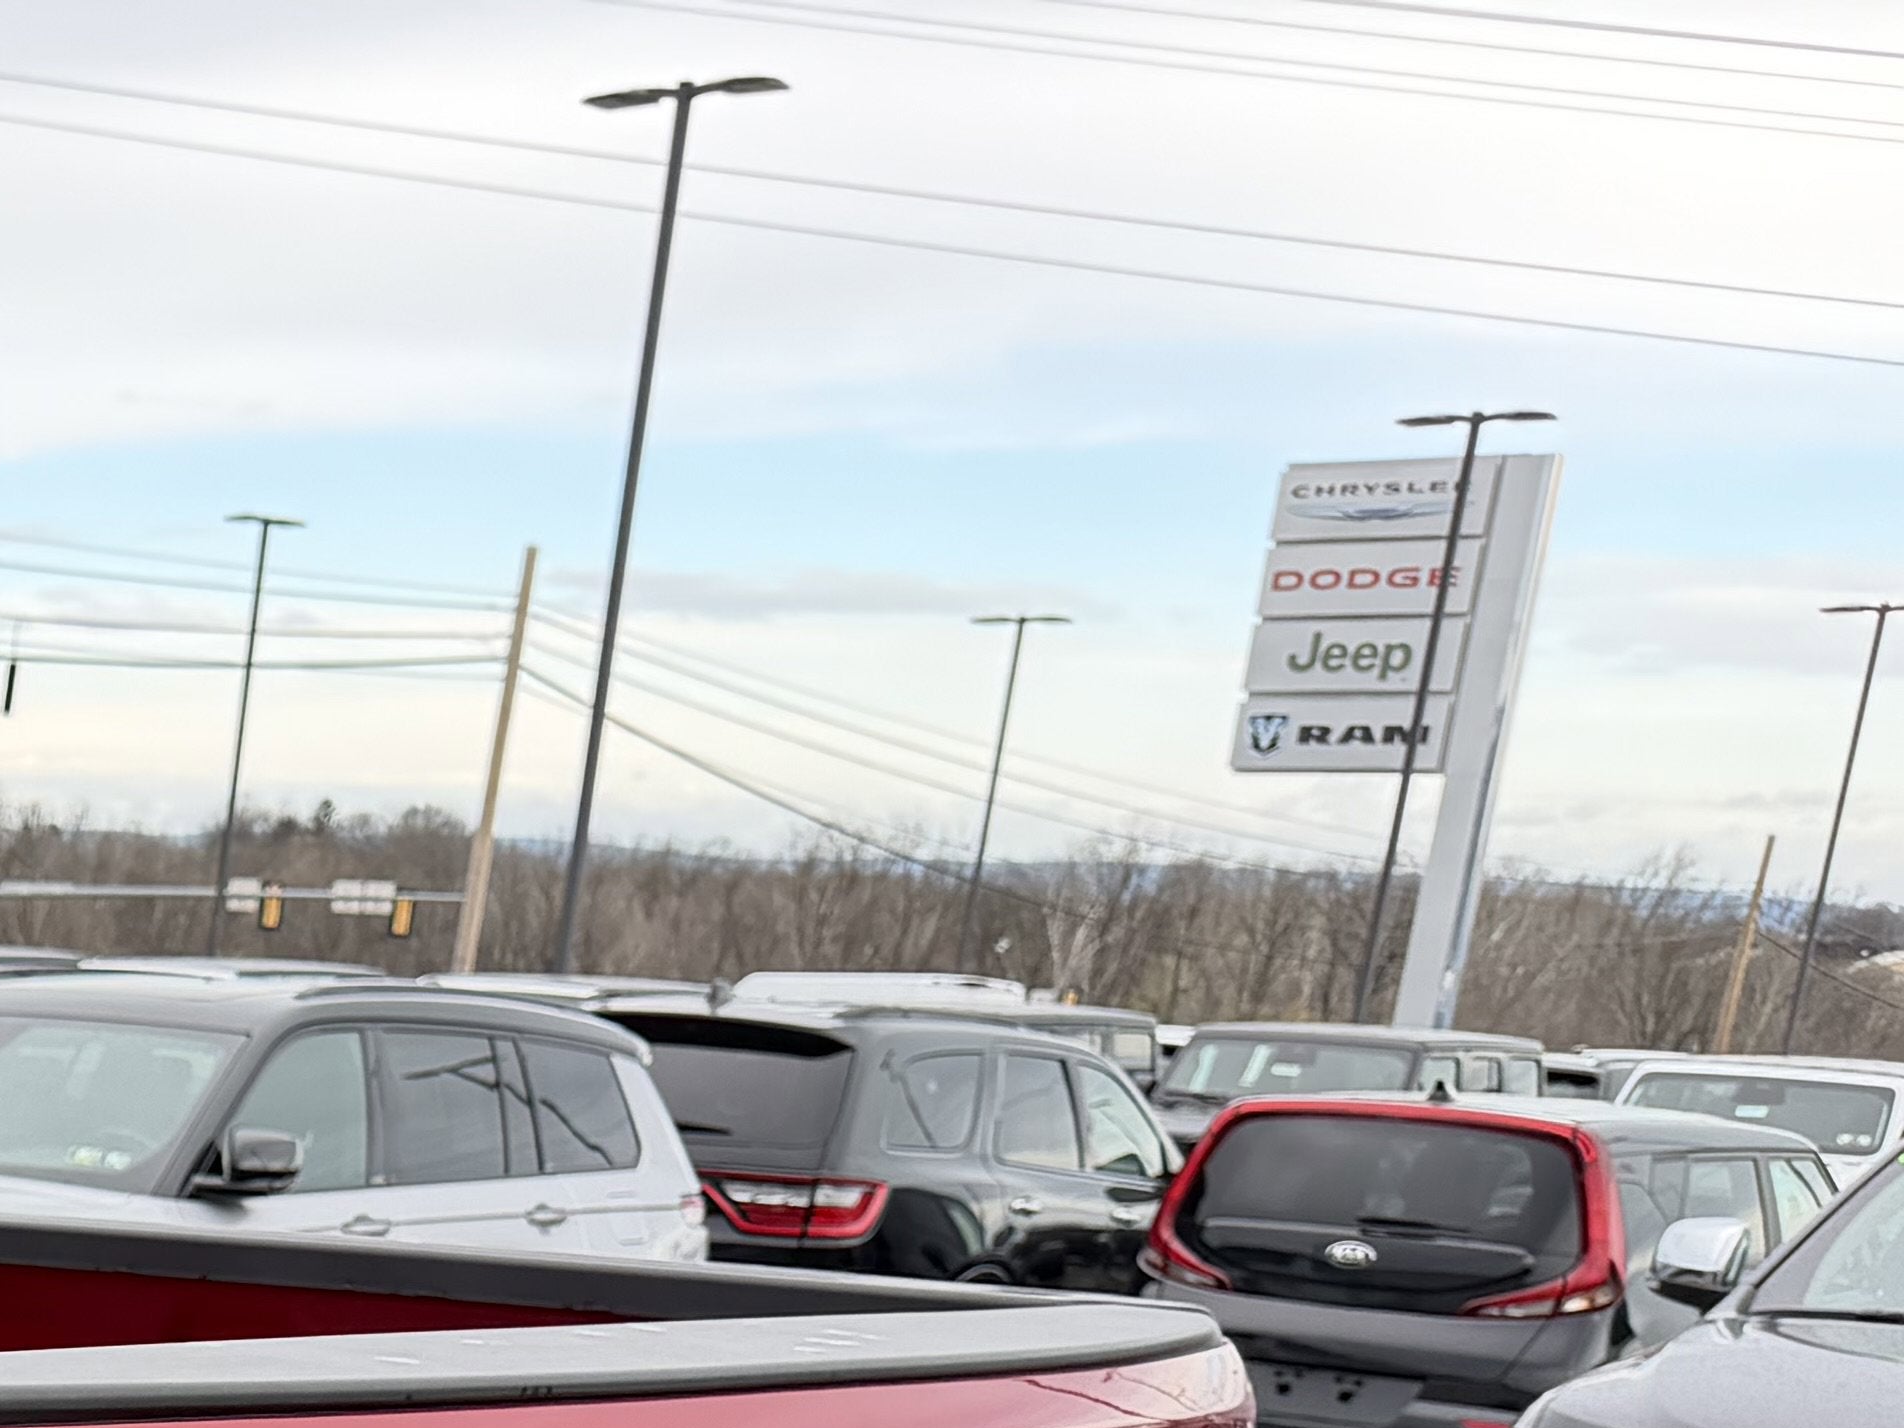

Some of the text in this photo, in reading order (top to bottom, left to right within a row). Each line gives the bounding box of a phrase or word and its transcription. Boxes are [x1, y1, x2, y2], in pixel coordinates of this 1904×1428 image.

[1272, 566, 1461, 592] DODGE
[1286, 631, 1413, 682] Jeep
[1296, 725, 1431, 745] RAM
